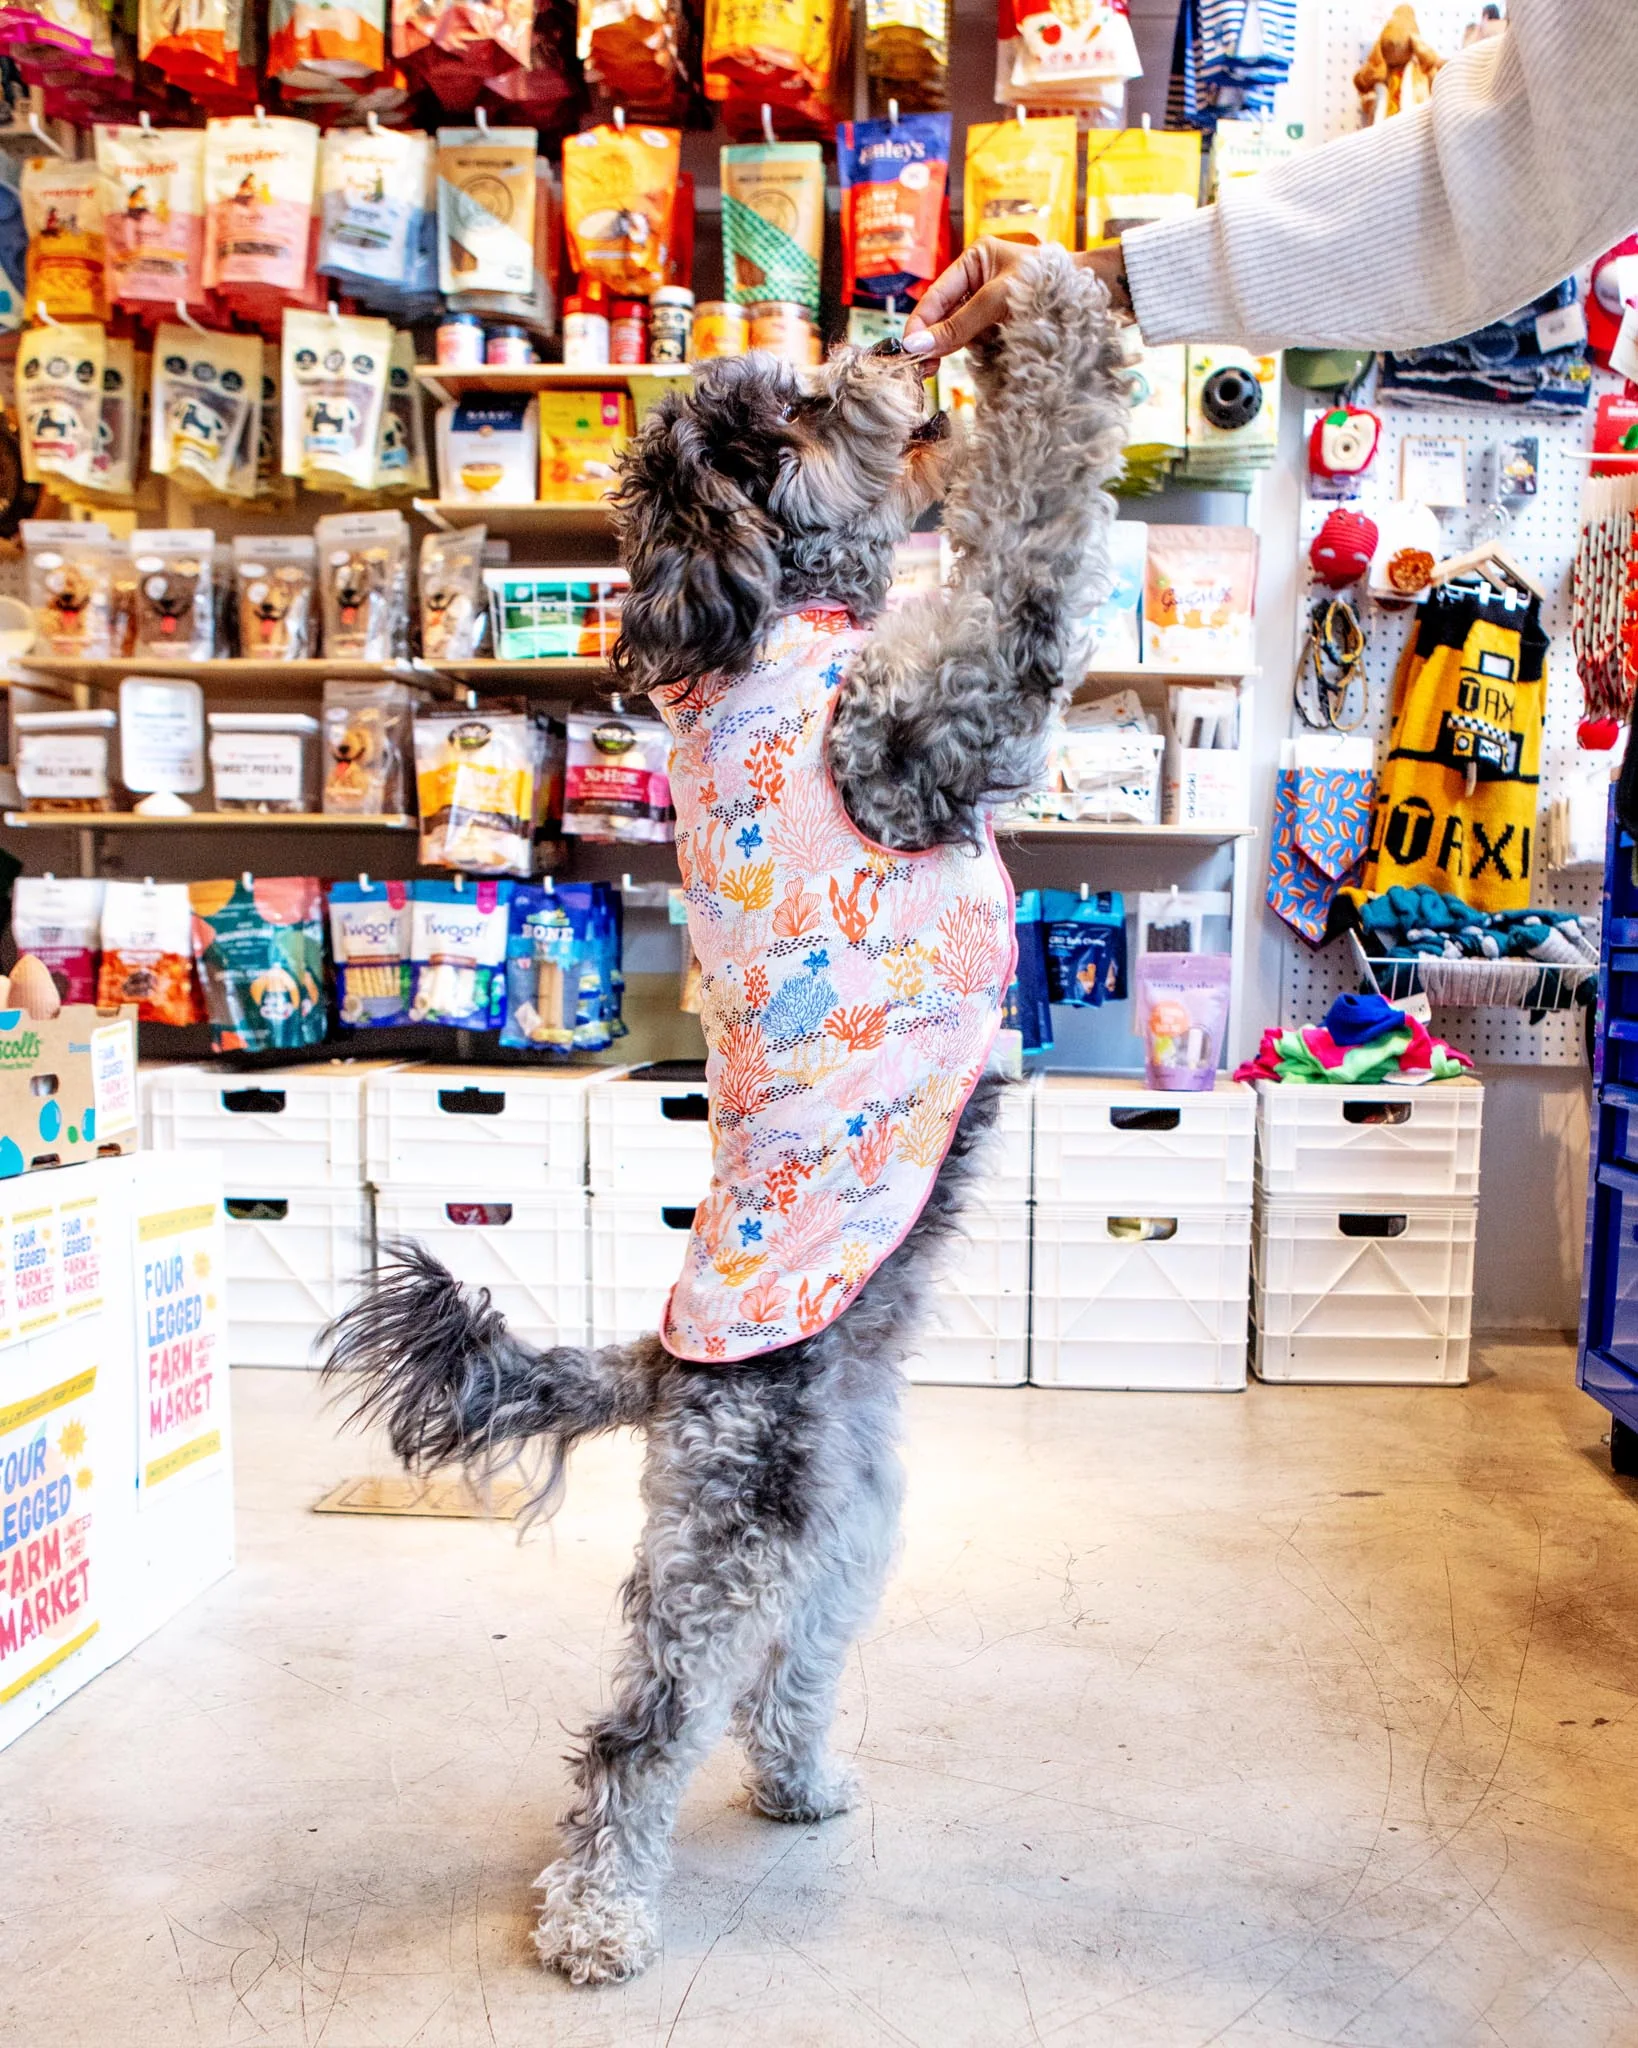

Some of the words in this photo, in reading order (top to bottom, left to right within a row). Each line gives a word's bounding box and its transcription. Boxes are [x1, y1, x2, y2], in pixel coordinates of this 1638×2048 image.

[1384, 797, 1530, 880] TAXI
[522, 923, 574, 942] BONE
[14, 1229, 35, 1250] FOUR
[63, 1235, 91, 1257] LEGGED
[14, 1248, 46, 1271] LEGGED
[64, 1256, 87, 1280] FARM
[16, 1268, 41, 1292] FARM
[65, 1271, 99, 1296] MARKET
[144, 1255, 184, 1301] FOUR
[17, 1285, 54, 1312] MARKET
[147, 1294, 202, 1348] LEGGED
[149, 1338, 193, 1394] FARM
[150, 1372, 213, 1439] MARKET
[0, 1557, 90, 1660] MARKET
